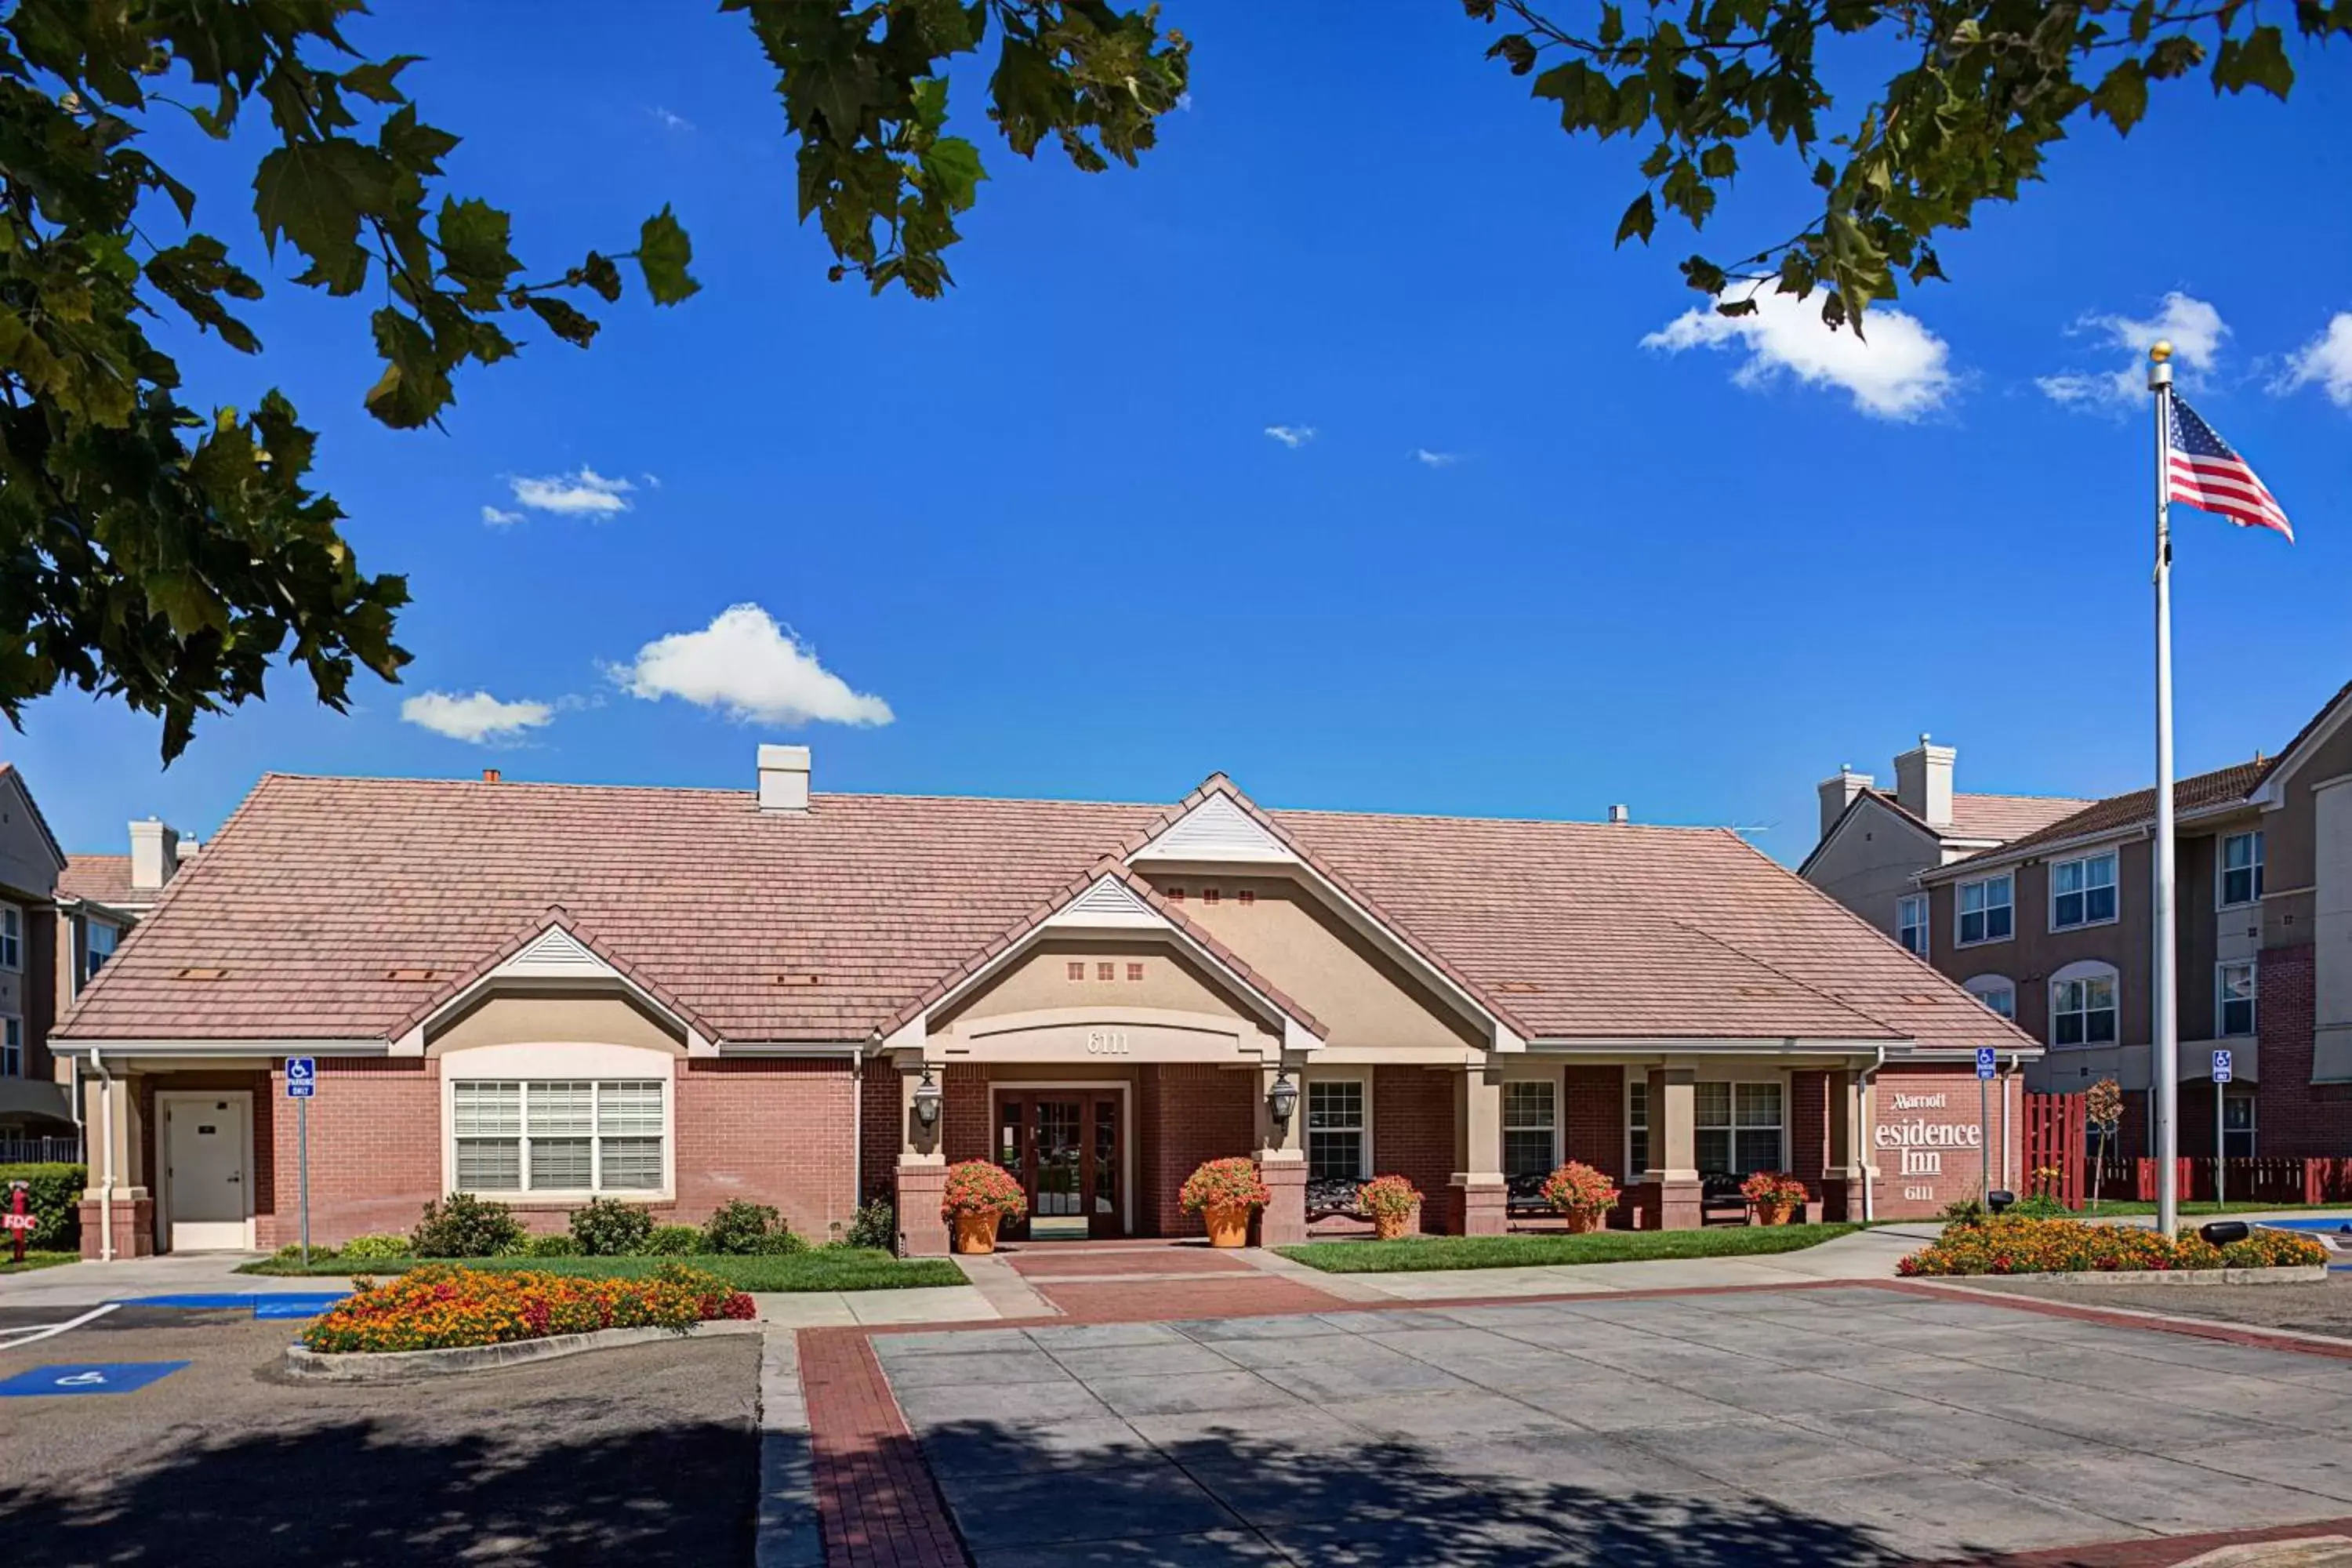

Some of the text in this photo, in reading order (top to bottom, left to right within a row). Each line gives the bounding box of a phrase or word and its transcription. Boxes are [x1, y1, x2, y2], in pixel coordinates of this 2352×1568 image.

[1087, 1031, 1129, 1054] 6111
[1875, 1118, 1980, 1146] esidence
[1900, 1146, 1941, 1175] Inn
[1904, 1185, 1933, 1200] 6111
[4, 1214, 35, 1229] FDC
